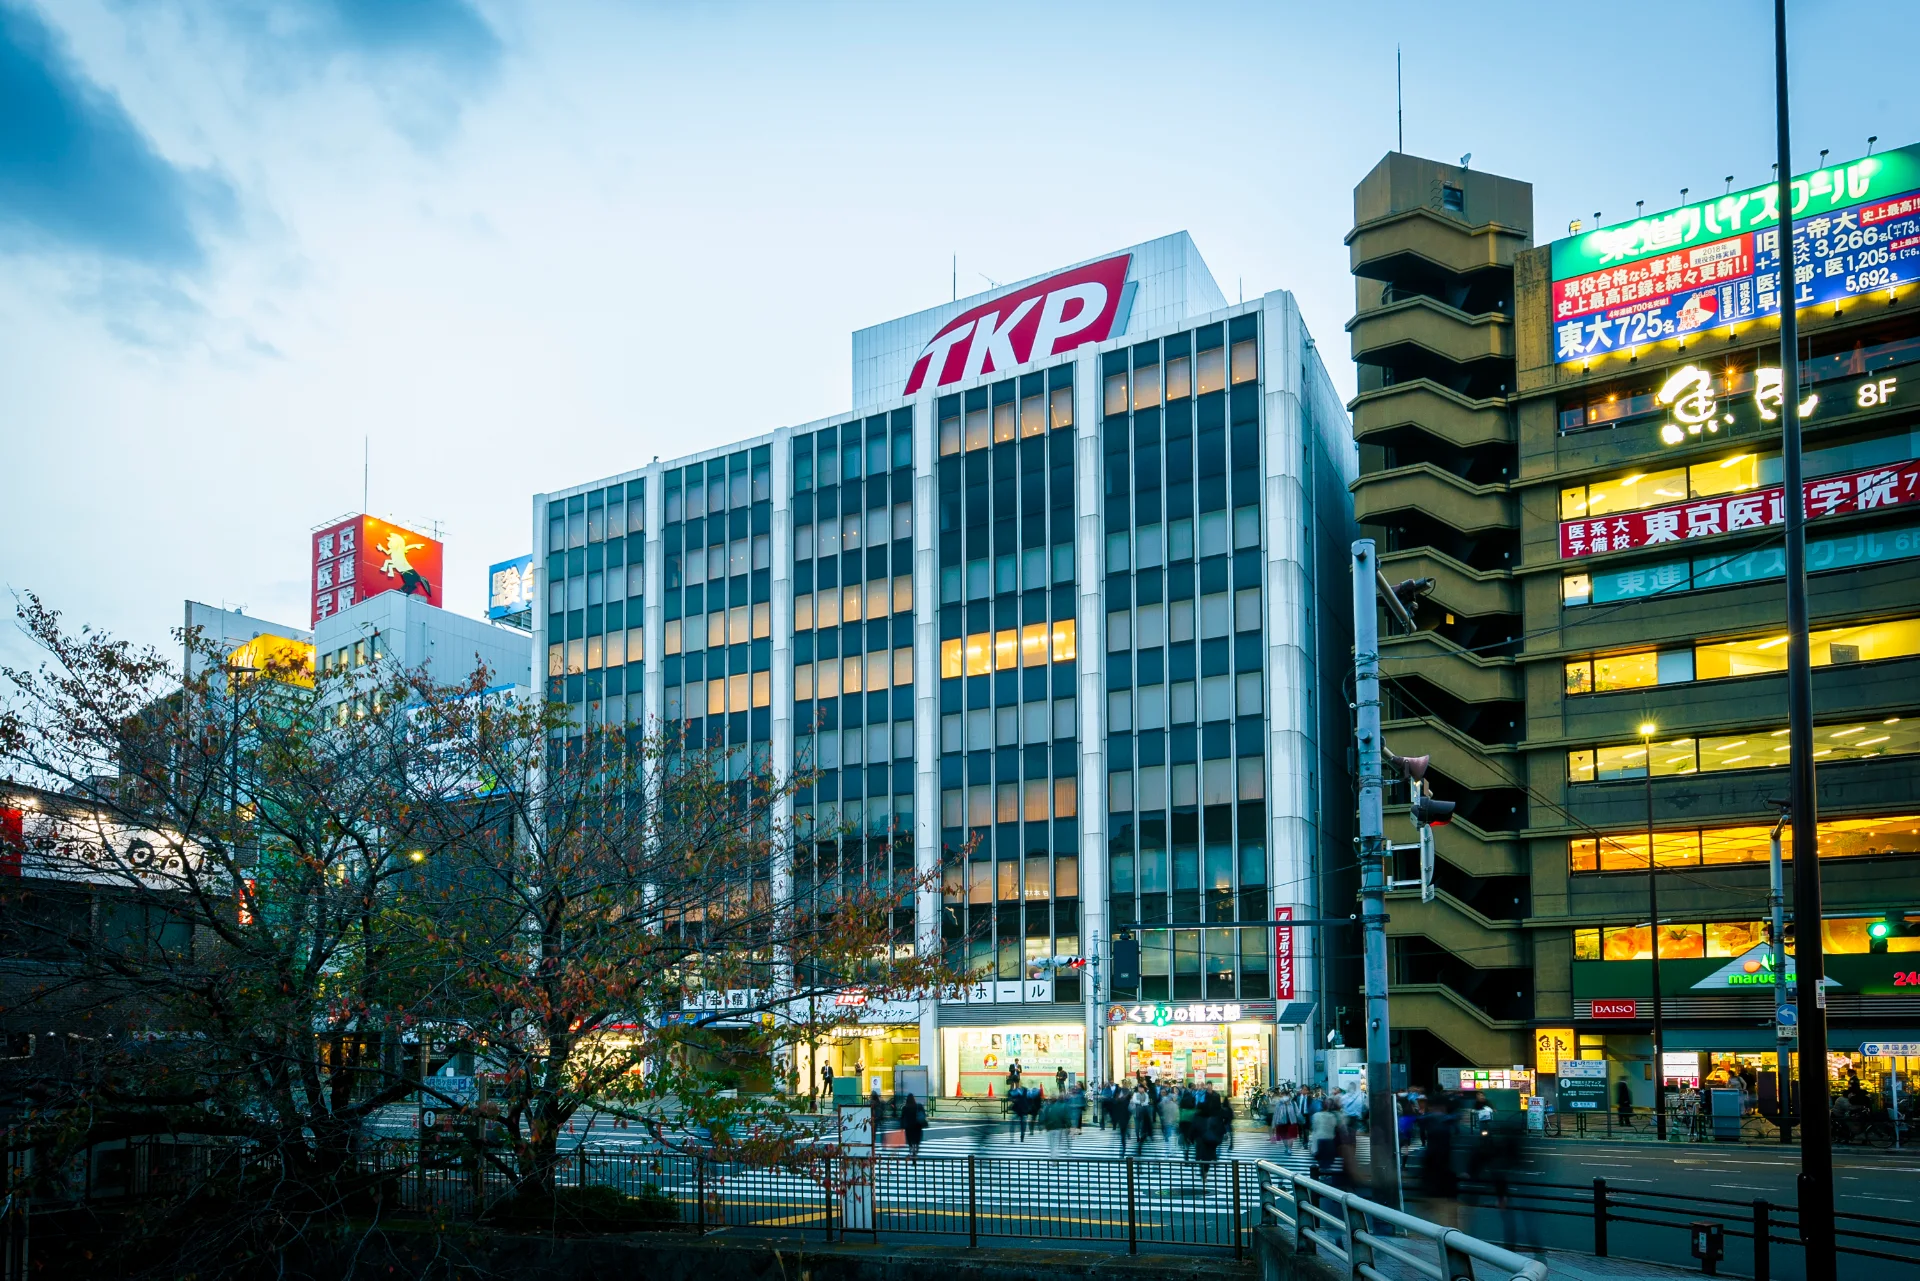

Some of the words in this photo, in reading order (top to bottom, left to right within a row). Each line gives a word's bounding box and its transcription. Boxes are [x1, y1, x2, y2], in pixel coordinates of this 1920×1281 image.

[1846, 267, 1898, 292] 5,692名
[1757, 285, 1815, 311] 早上
[917, 281, 1108, 389] TKP
[1557, 309, 1675, 359] 東大725名
[1858, 378, 1896, 407] 8F
[1568, 518, 1630, 539] 医系大
[1568, 534, 1630, 556] 予備校
[1279, 927, 1290, 996] ニッポンレンタカー
[1594, 1005, 1633, 1013] DAISO
